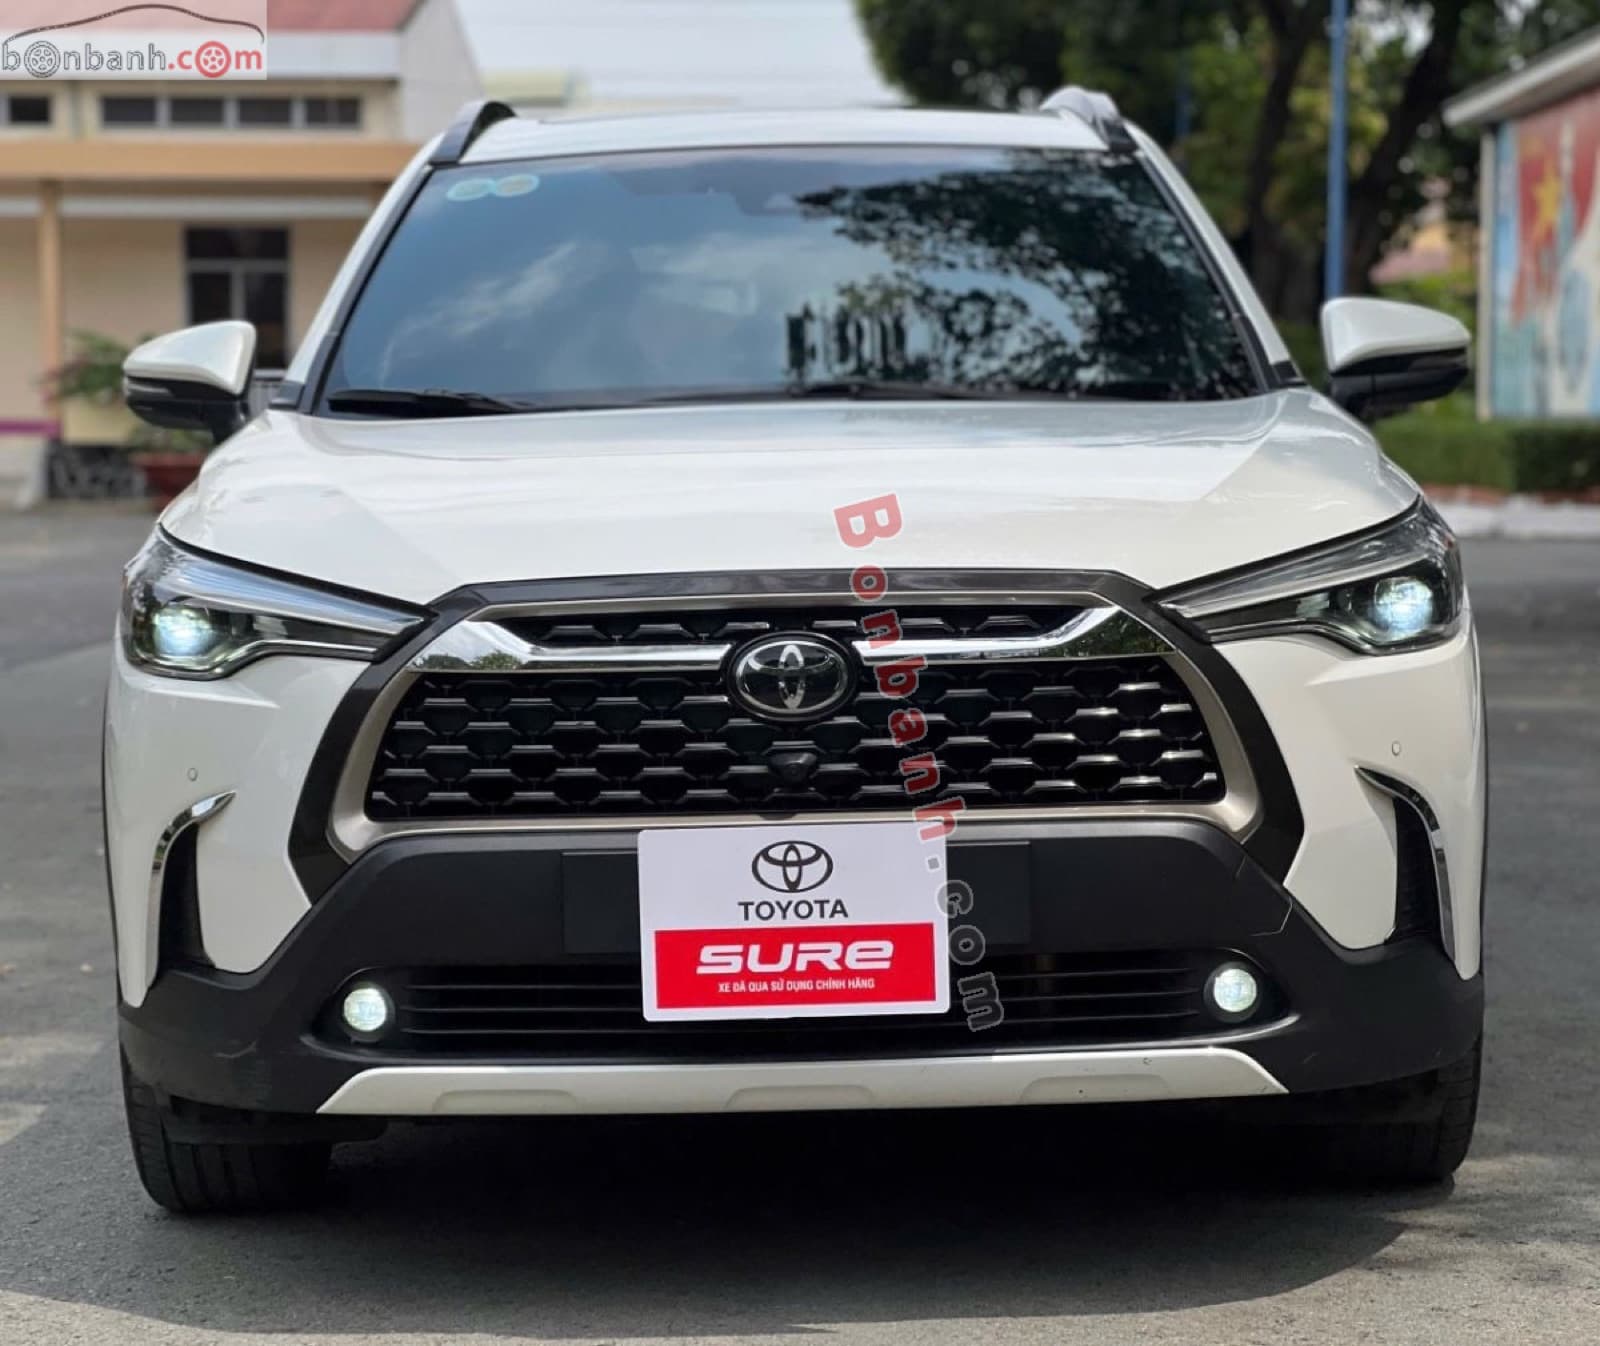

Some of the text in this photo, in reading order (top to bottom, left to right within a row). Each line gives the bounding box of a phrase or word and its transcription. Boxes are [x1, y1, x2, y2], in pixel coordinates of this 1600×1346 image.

[737, 899, 849, 921] TOYOTA
[718, 982, 732, 993] XE
[748, 981, 769, 993] QUA
